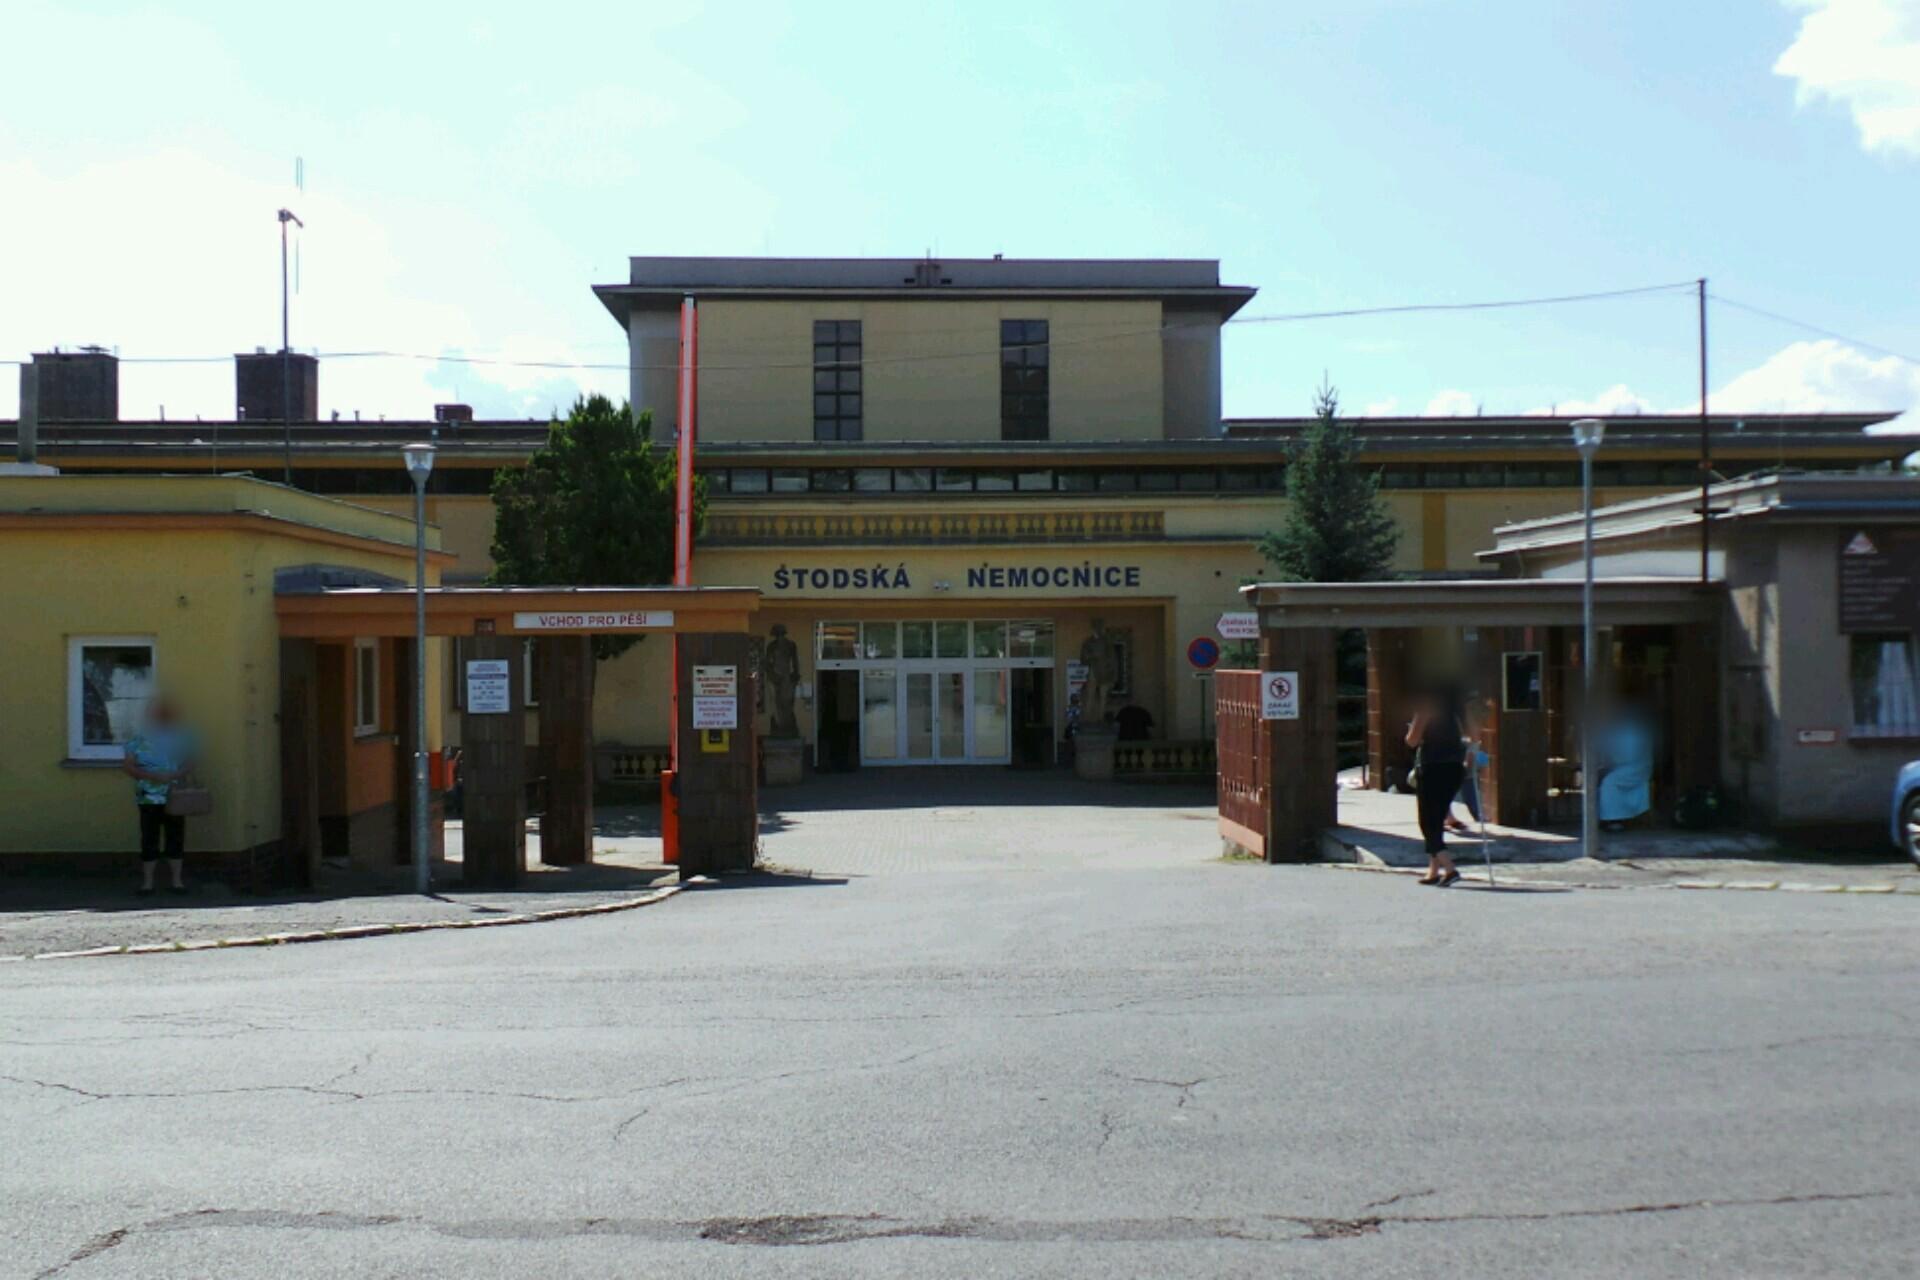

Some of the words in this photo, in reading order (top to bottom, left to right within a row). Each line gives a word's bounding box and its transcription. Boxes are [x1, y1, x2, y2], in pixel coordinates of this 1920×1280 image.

[967, 566, 1141, 588] NEMOCNICE
[539, 615, 584, 627] VCHOD
[588, 615, 615, 626] PRO
